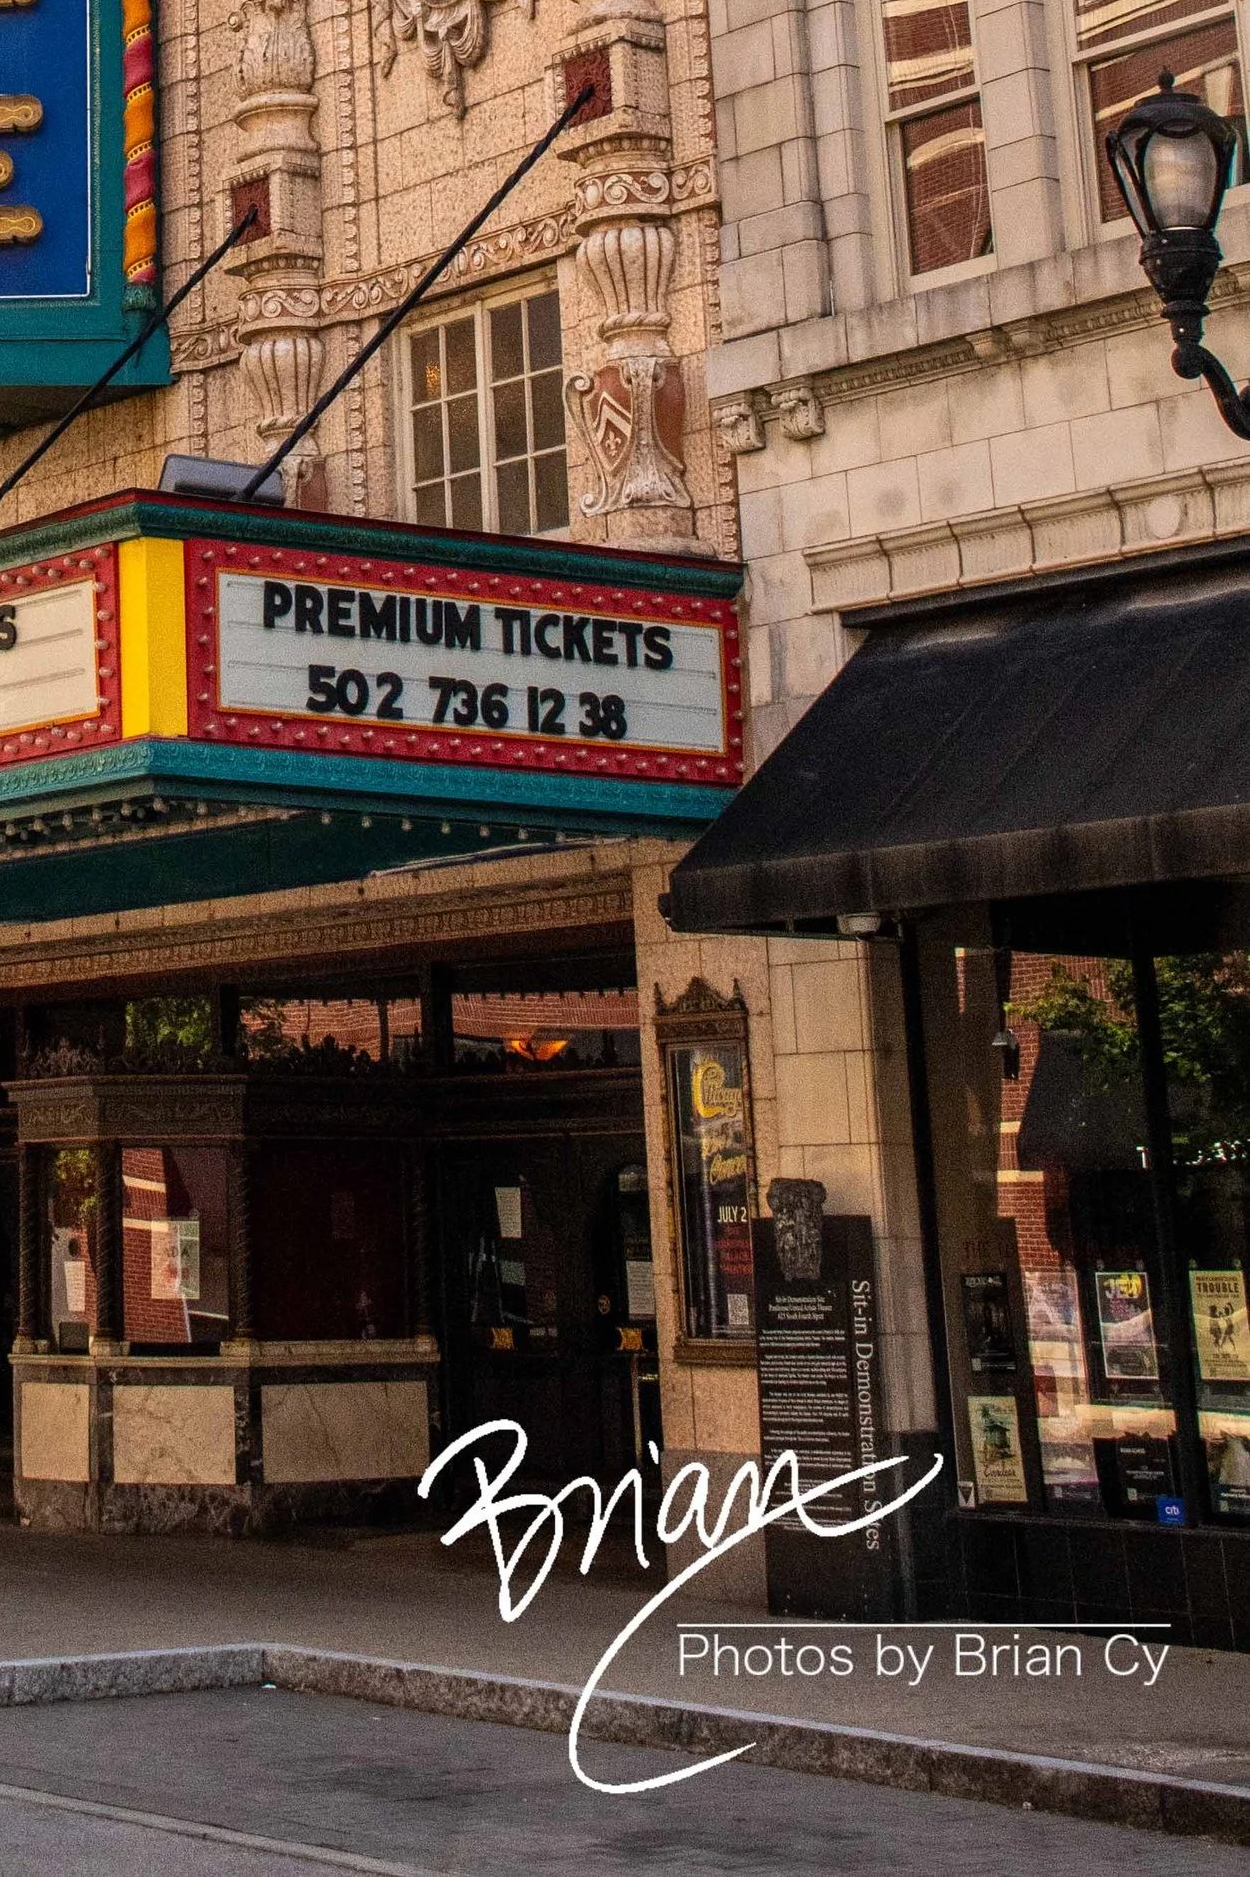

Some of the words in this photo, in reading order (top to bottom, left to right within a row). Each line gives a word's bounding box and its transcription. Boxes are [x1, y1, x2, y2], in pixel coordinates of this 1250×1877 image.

[263, 580, 481, 651] PREMIUM
[494, 606, 673, 671] TICKETS
[306, 664, 404, 719] 502
[429, 676, 509, 728] 736
[717, 1206, 738, 1223] JULY
[1197, 1282, 1240, 1294] TROUBLE
[852, 1280, 872, 1335] Sit-in
[864, 1501, 882, 1550] Stes
[1165, 1505, 1180, 1515] citi
